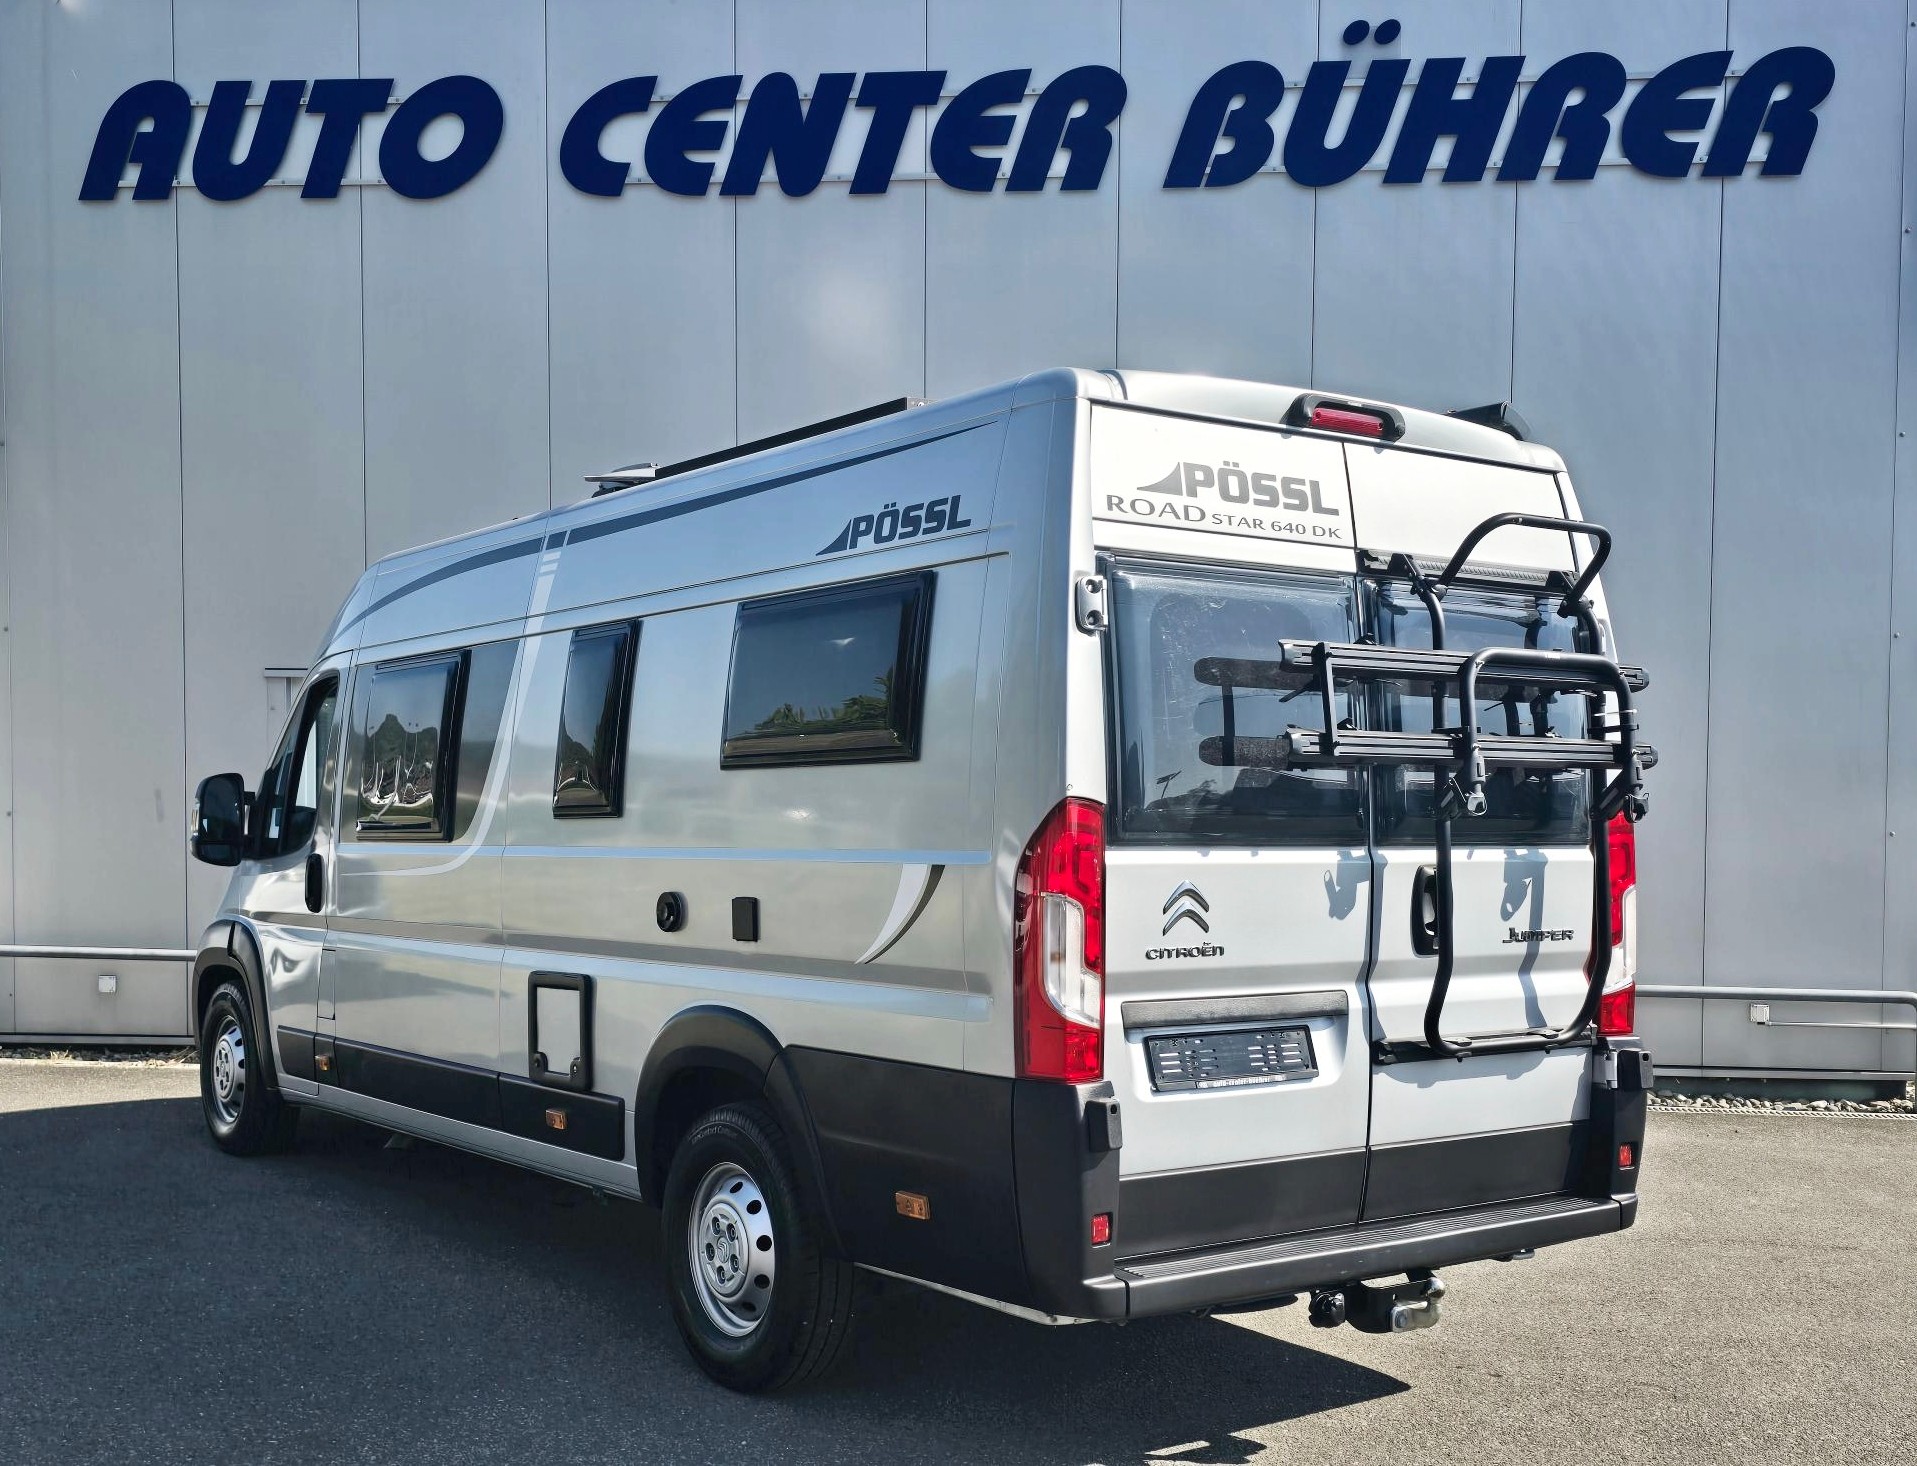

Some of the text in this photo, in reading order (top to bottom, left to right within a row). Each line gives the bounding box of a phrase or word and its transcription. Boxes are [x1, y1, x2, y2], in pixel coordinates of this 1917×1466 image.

[78, 19, 1835, 201] AUTO CENTER BÜHRER
[1183, 461, 1340, 516] PÖSSL
[849, 495, 972, 549] PÖSSL
[1106, 494, 1342, 539] ROAD STAR 640 DK
